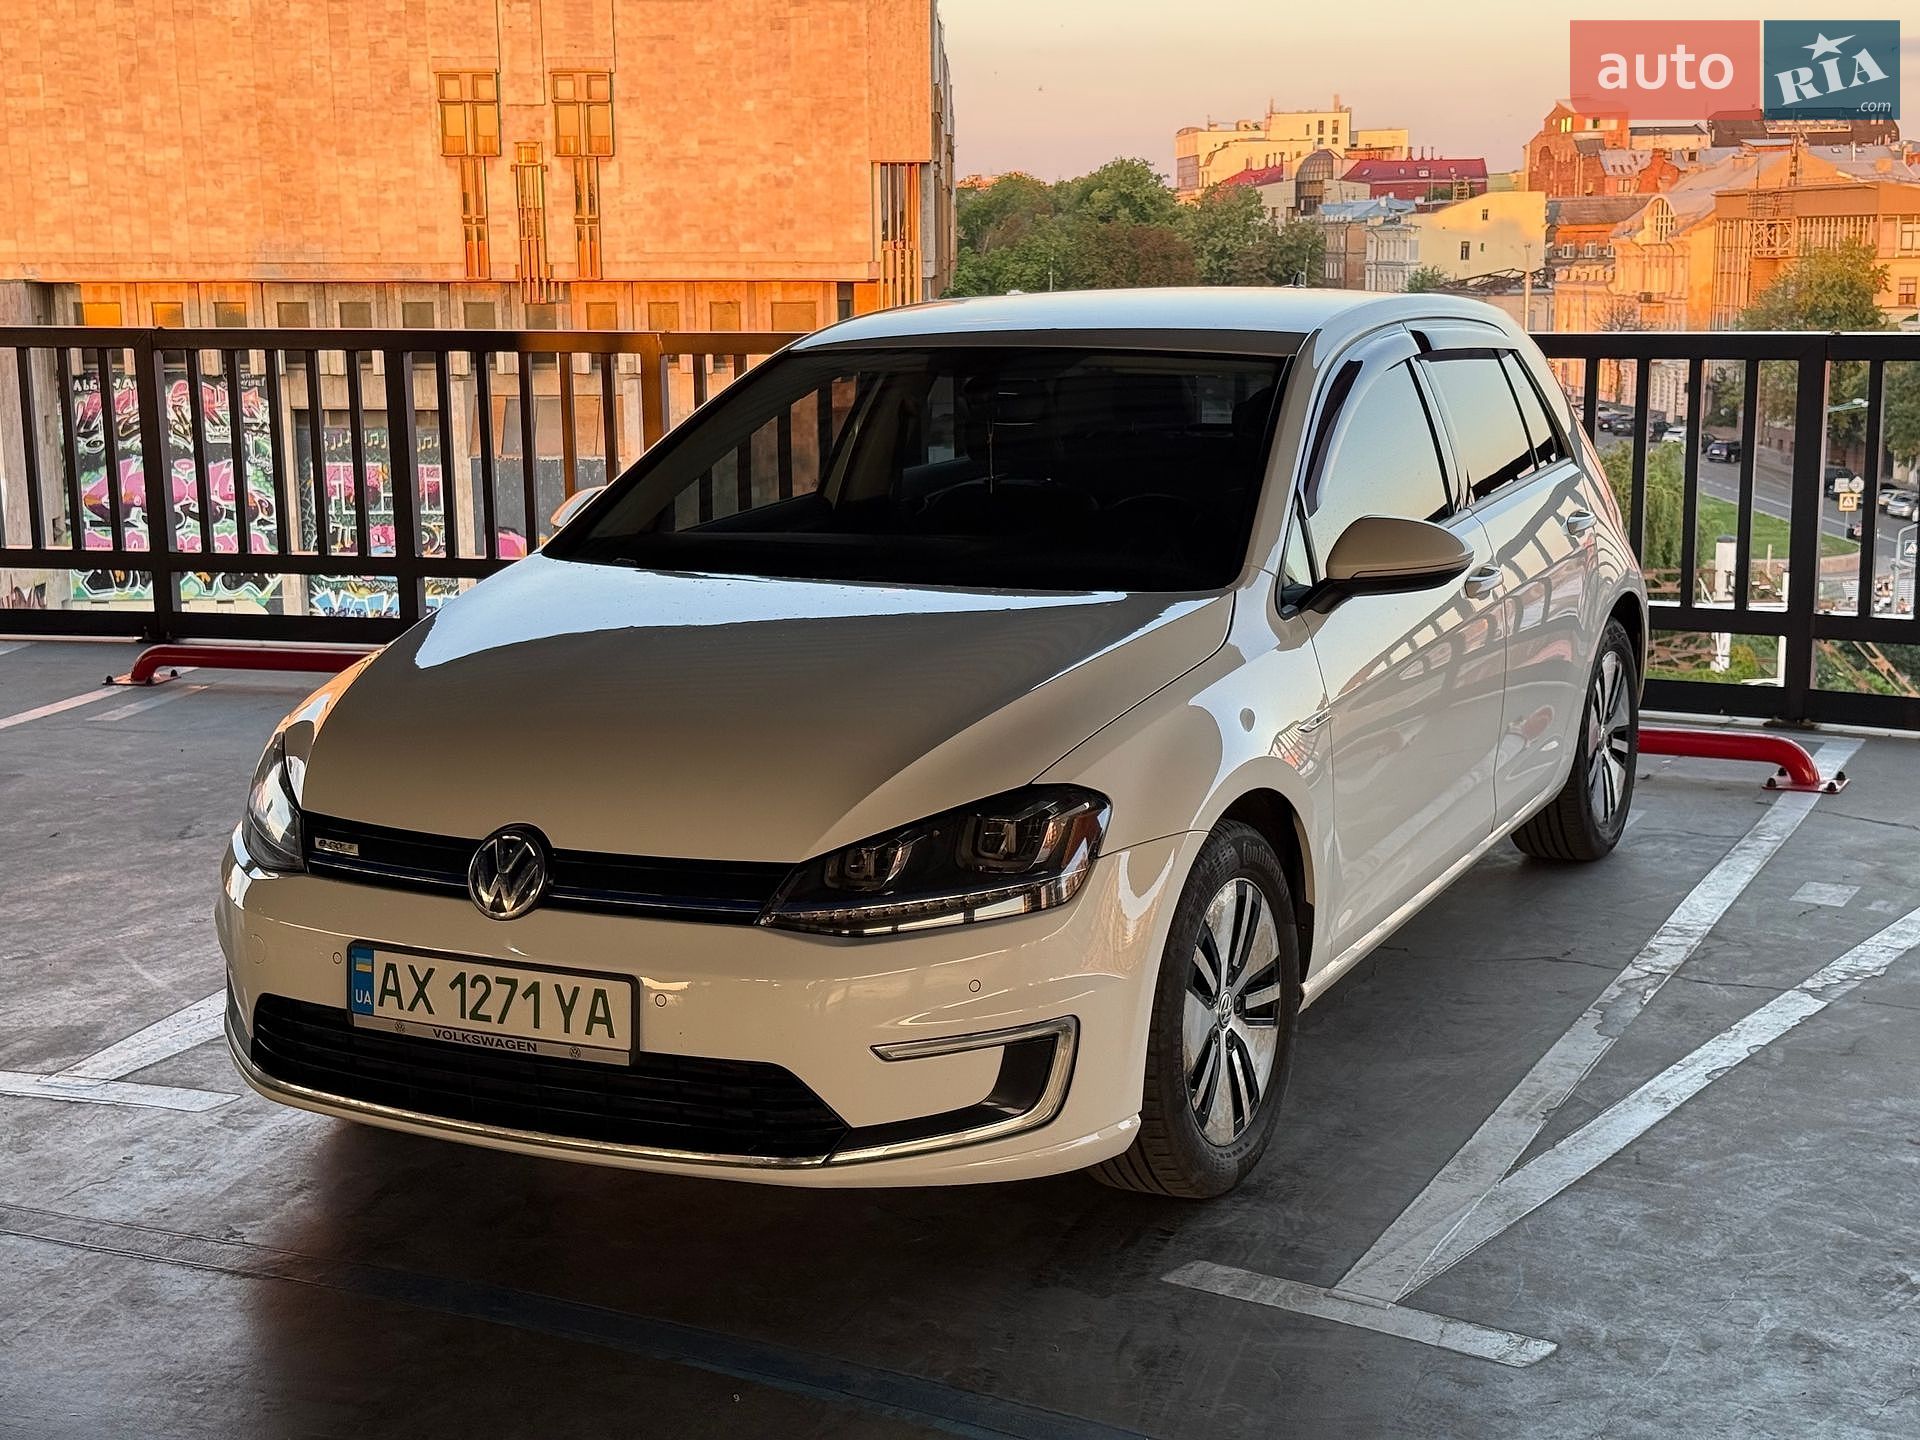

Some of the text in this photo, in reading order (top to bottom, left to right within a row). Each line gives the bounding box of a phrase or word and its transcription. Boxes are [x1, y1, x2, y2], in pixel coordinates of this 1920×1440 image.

[355, 988, 373, 1005] UA
[378, 962, 616, 1039] AX 1271 YA
[432, 1028, 537, 1053] VOLKSWAGEN
